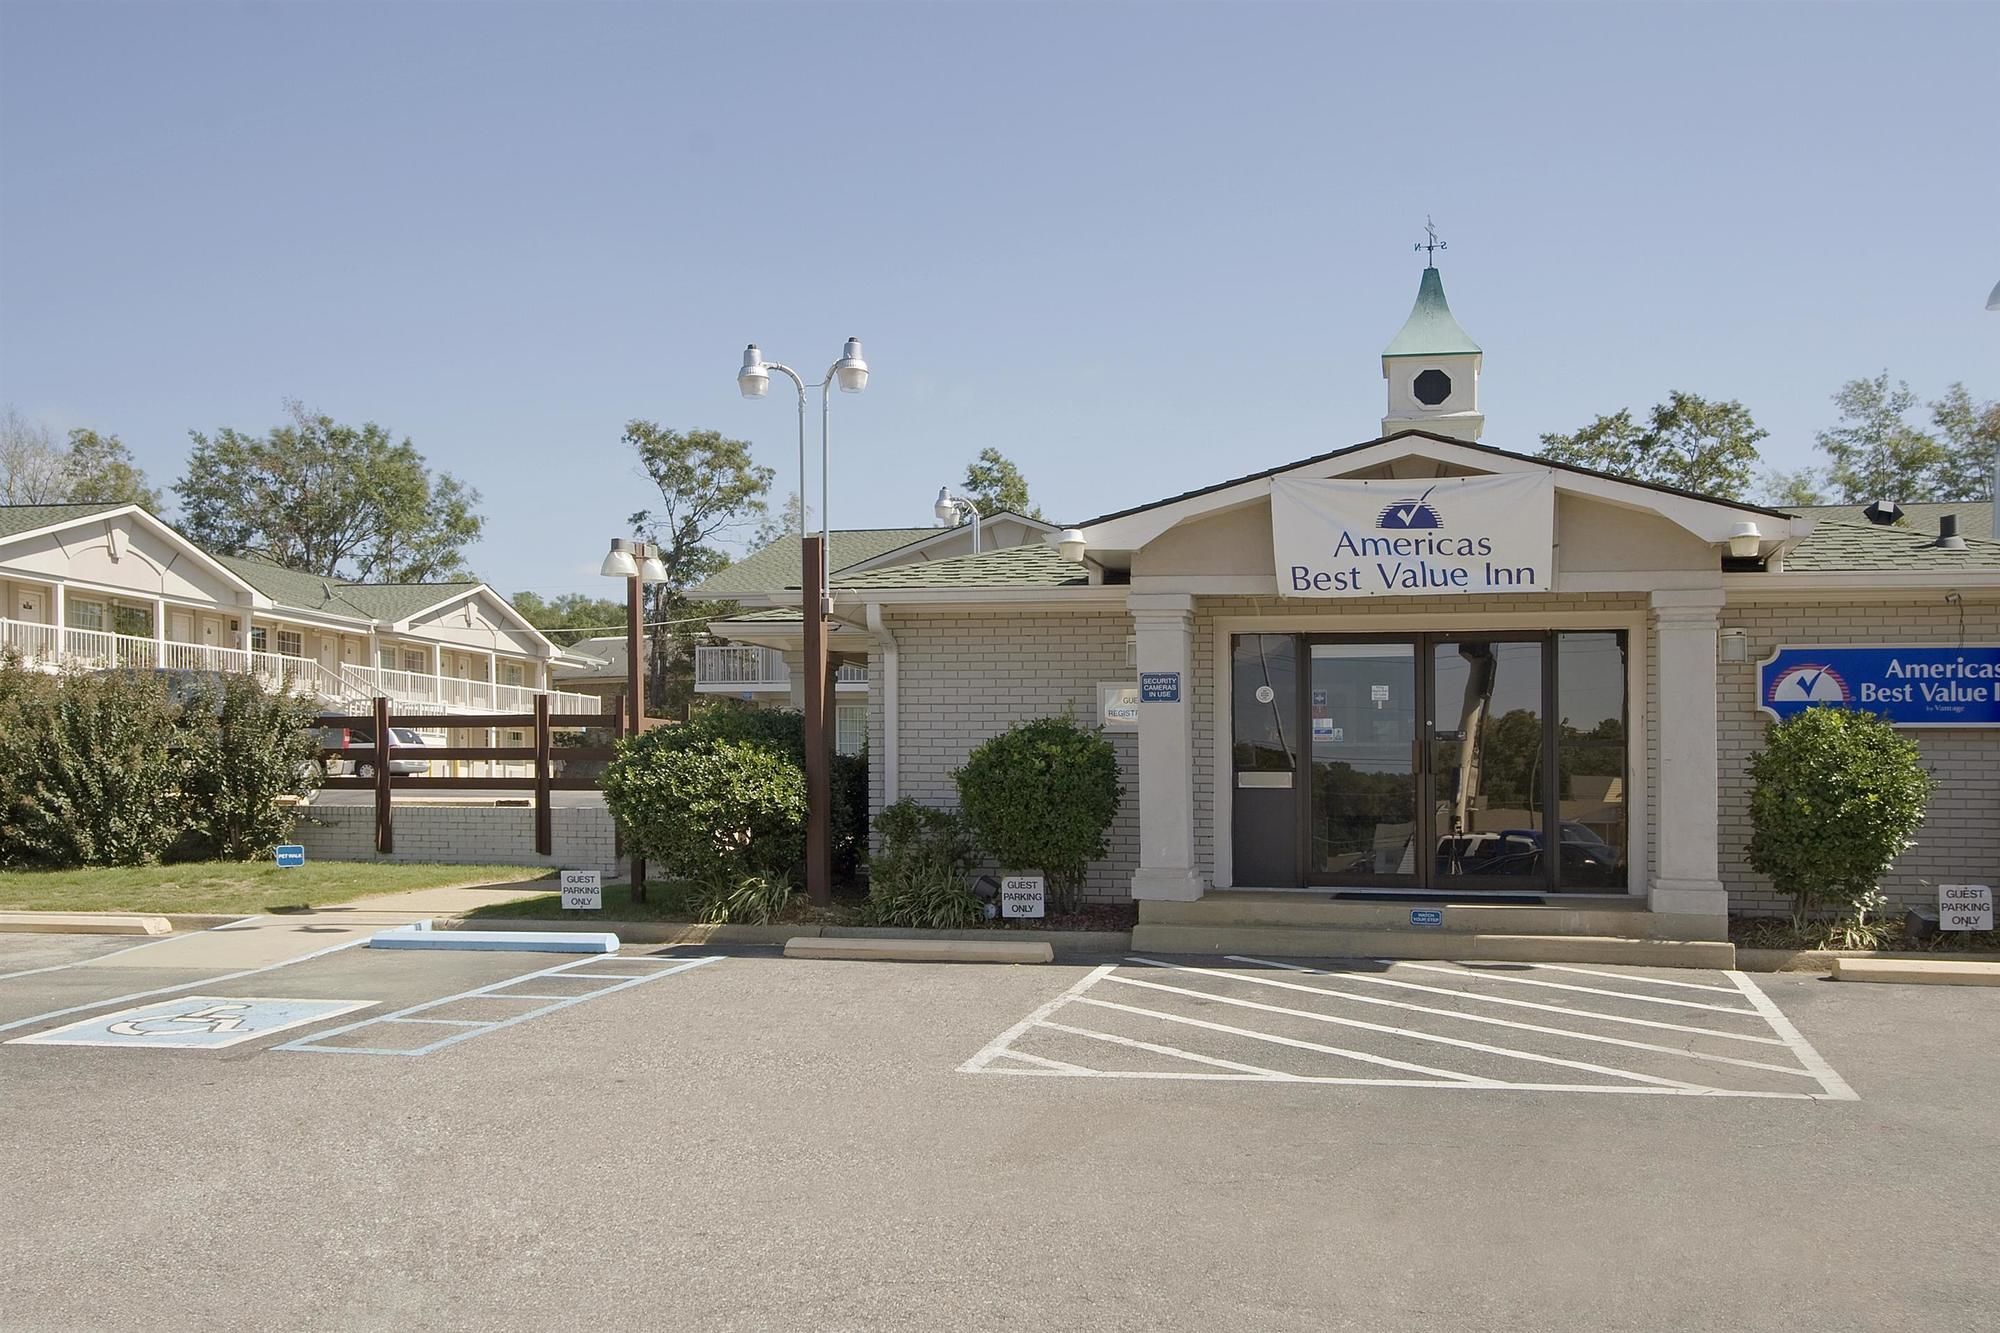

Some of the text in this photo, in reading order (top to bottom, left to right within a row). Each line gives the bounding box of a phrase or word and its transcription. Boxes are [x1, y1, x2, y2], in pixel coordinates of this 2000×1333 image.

[1333, 530, 1492, 558] Americas
[1291, 560, 1536, 591] Best Value Inn
[1861, 682, 1913, 703] Best
[1919, 680, 1988, 703] Value
[1934, 705, 1965, 713] Vantage
[566, 875, 596, 883] GUEST
[1007, 881, 1038, 889] GUEST
[563, 887, 600, 895] PARKING
[1946, 889, 1985, 898] GUEST
[1003, 893, 1042, 901] PARKING
[1011, 904, 1034, 912] ONLY
[1941, 903, 1990, 911] PARKING
[1951, 916, 1980, 925] ONLY
